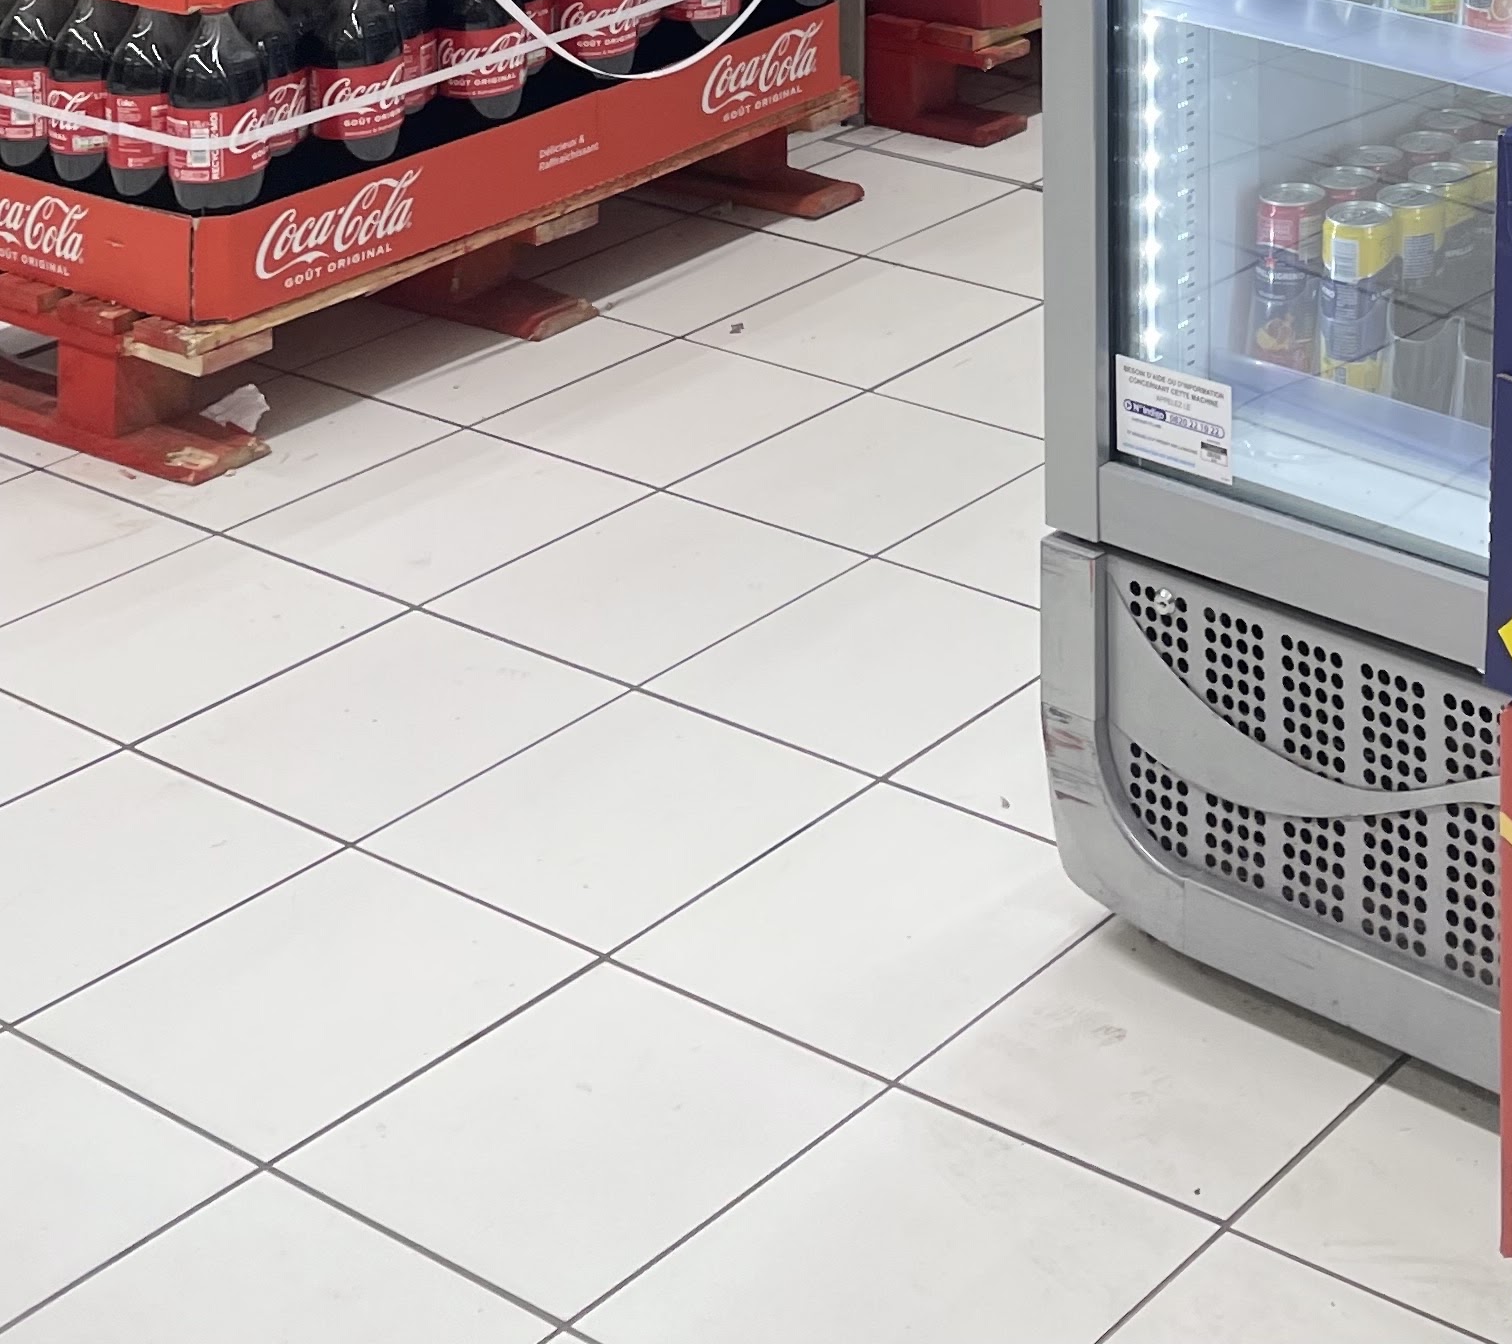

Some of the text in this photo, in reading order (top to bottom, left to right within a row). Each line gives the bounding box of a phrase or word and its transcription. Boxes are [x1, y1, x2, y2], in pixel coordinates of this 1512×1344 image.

[722, 86, 803, 123] GOÛT ORIGINAL
[20, 253, 70, 277] ORIGINAL
[285, 242, 393, 289] GOÛT ORIGINAL
